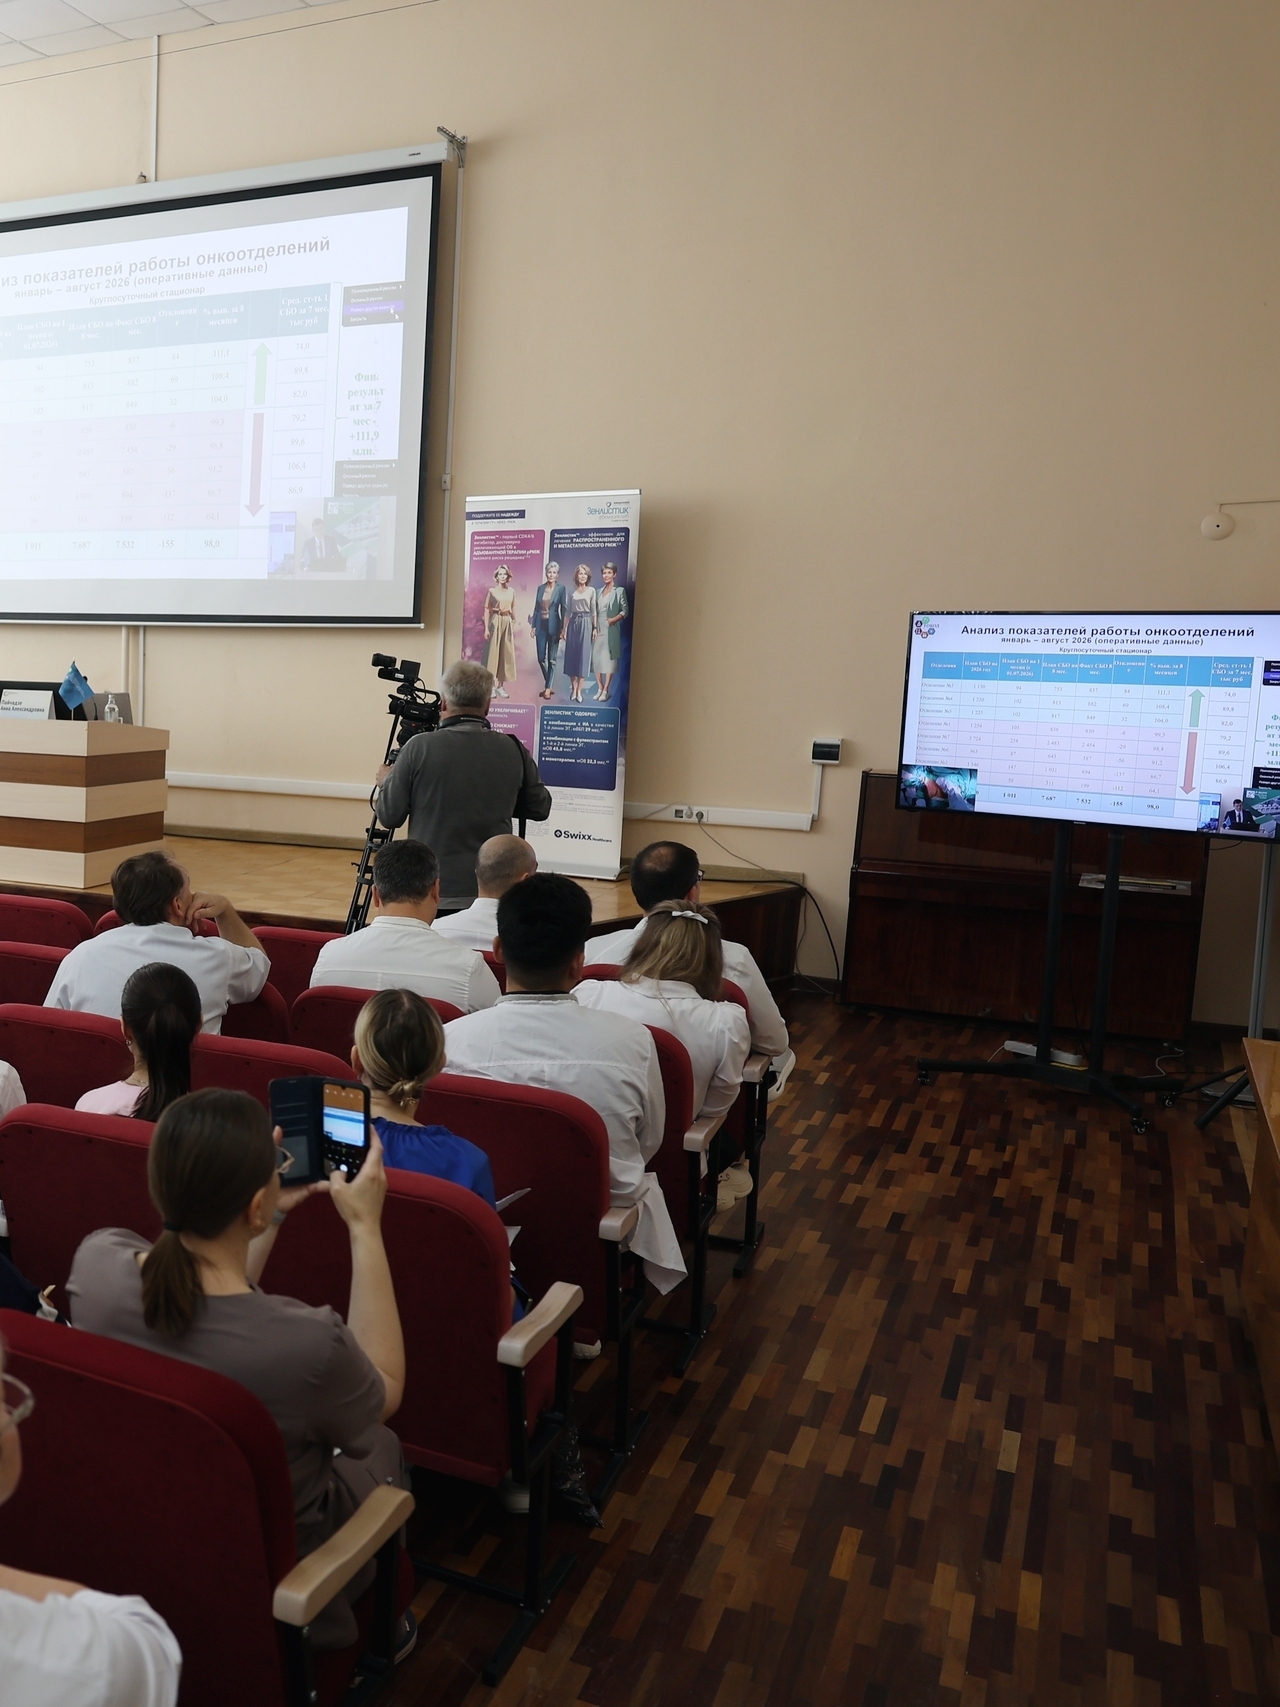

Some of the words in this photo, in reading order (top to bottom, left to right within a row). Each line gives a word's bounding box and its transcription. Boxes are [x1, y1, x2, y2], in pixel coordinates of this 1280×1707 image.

[23, 261, 123, 285] показателей
[129, 256, 189, 276] работы
[196, 236, 330, 266] онкоотделений
[14, 287, 53, 299] январь
[66, 282, 101, 294] август
[105, 277, 130, 288] 2026
[133, 270, 214, 287] (оперативные
[218, 261, 268, 278] данные)
[89, 291, 158, 305] Круглосуточный
[160, 287, 205, 297] стационар
[279, 307, 297, 316] СБО
[295, 342, 310, 351] 74,0
[213, 349, 230, 358] 111,1
[294, 366, 309, 375] 89,8
[212, 372, 229, 380] 108,4
[292, 389, 308, 398] 82,0
[347, 388, 385, 399] результ
[210, 394, 228, 403] 104,0
[376, 401, 381, 409] 7
[292, 414, 307, 422] 79,2
[349, 431, 380, 442] +111,9
[290, 437, 305, 446] 89,6
[288, 461, 306, 470] 106,4
[288, 486, 303, 495] 86,9
[122, 541, 135, 549] 532
[204, 539, 220, 549] 98,0
[961, 626, 1004, 635] Анализ
[1009, 626, 1087, 636] показателей
[1091, 627, 1140, 637] работы
[1145, 627, 1254, 637] онкоотделений
[1072, 637, 1092, 645] 2026
[1162, 638, 1204, 646] данные)
[563, 831, 592, 841] Swixx
